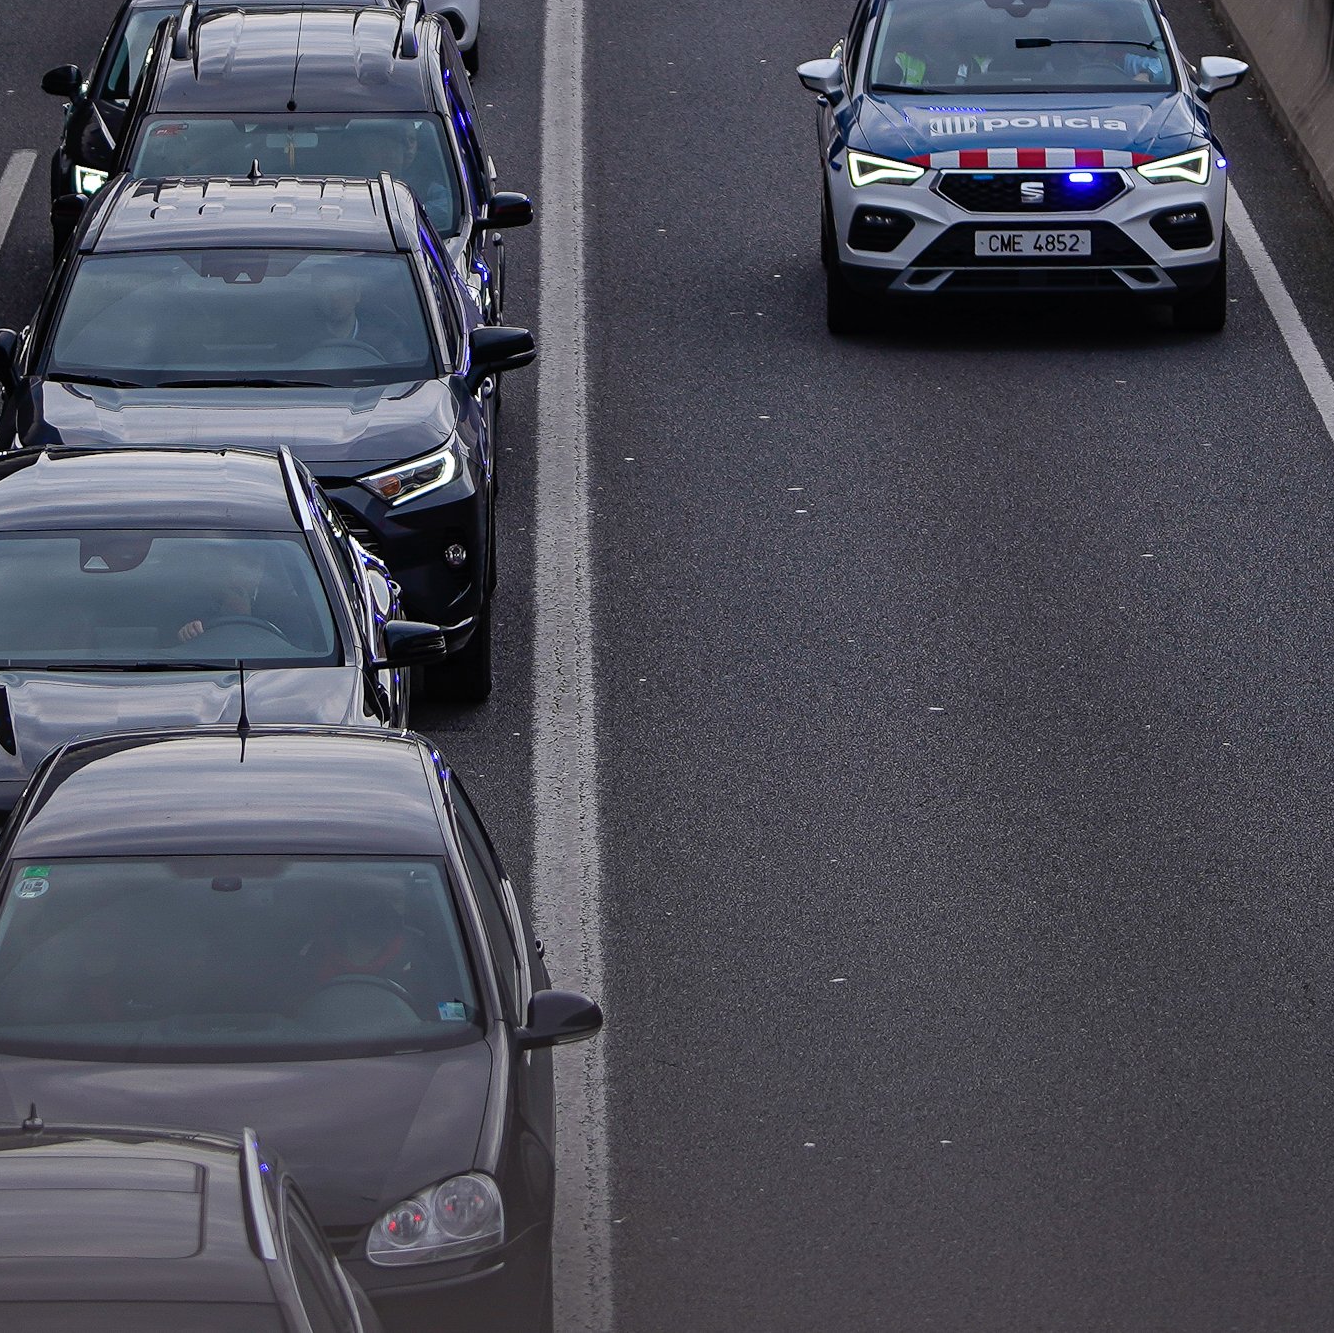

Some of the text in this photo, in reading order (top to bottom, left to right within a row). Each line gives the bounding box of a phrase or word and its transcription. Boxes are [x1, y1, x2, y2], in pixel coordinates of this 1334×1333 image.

[982, 115, 1128, 132] policia
[988, 234, 1080, 252] CME 4852
